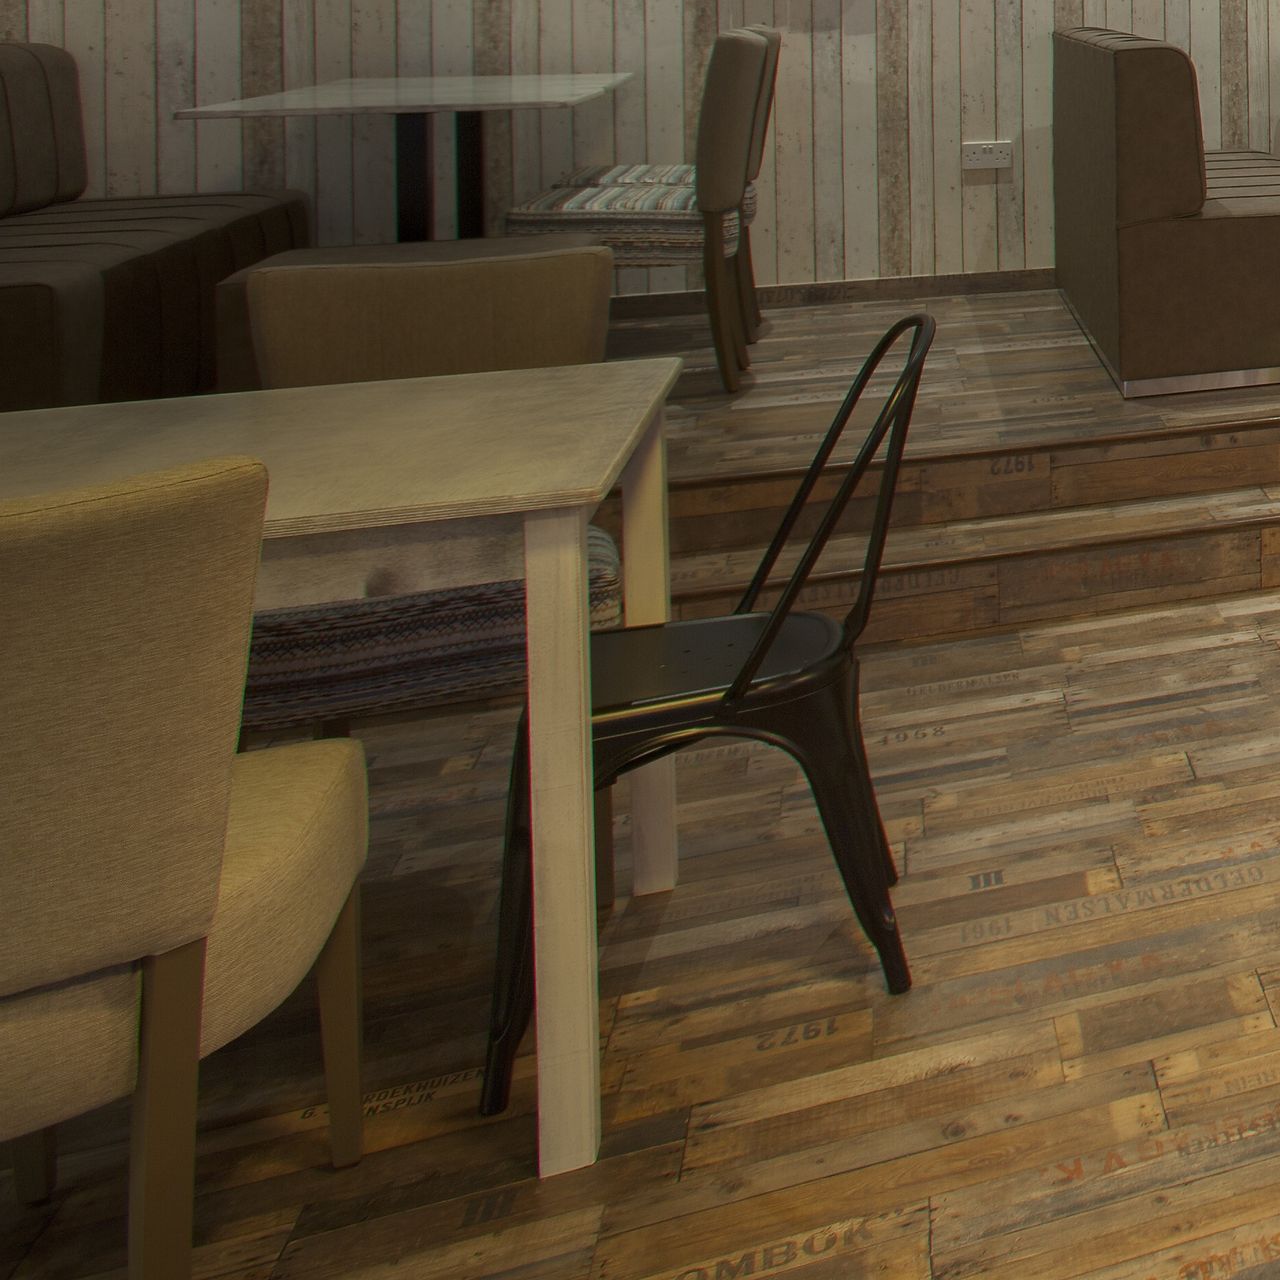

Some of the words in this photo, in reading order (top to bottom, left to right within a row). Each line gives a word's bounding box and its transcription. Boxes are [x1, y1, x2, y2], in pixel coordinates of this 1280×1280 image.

[990, 455, 1035, 475] 1972
[1043, 865, 1265, 926] GELDERMALSEN
[756, 1016, 840, 1052] 1972
